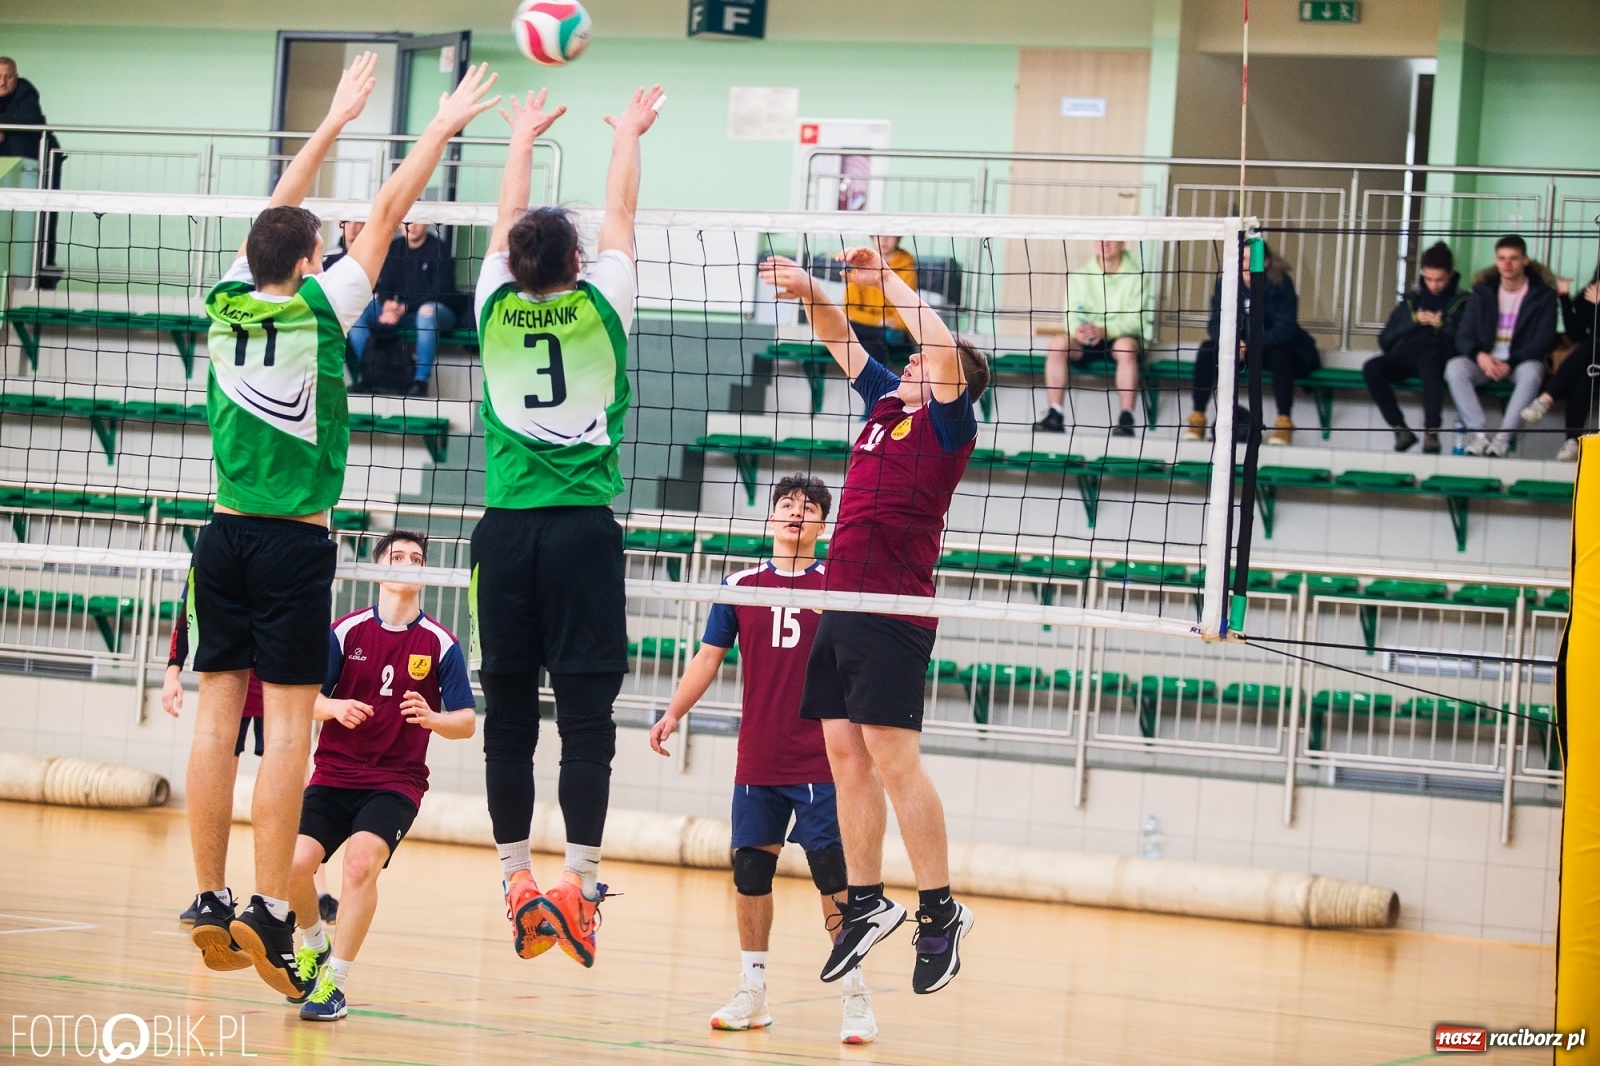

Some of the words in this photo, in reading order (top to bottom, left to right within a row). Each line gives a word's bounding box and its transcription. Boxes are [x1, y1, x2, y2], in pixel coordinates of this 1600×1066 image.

[691, 6, 704, 31] F
[722, 5, 751, 31] F
[502, 306, 578, 328] MECHANIK
[230, 317, 278, 366] 11
[523, 332, 567, 409] 3
[771, 606, 801, 648] 15
[379, 664, 395, 697] 2
